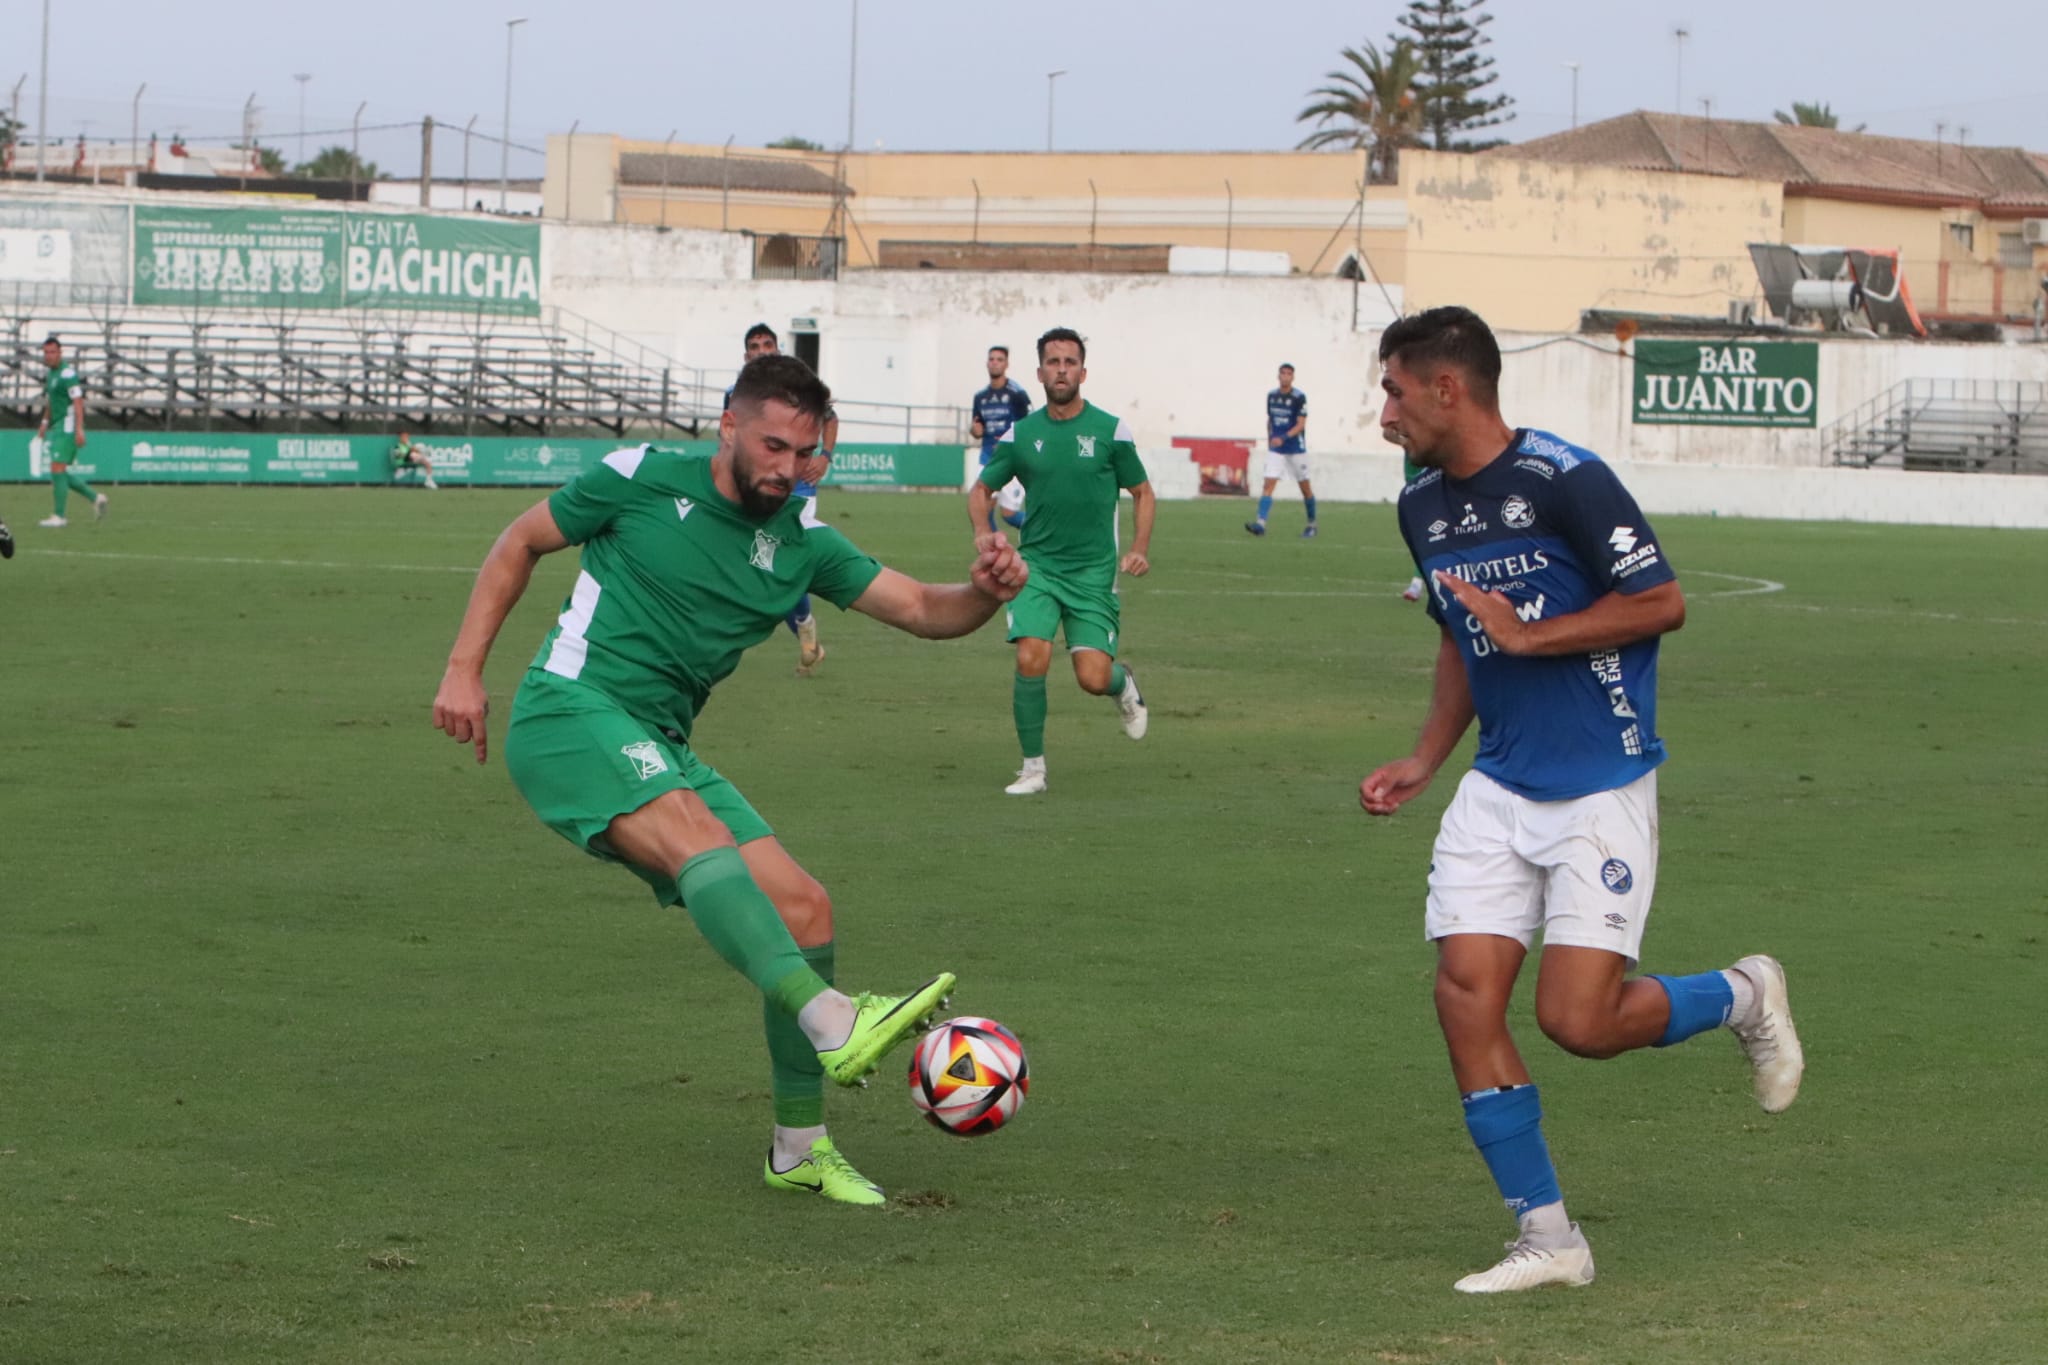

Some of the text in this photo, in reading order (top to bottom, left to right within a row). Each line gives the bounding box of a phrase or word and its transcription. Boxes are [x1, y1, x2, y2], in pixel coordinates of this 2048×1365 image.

[347, 220, 420, 246] VENTA
[153, 247, 325, 293] INFANTE
[348, 245, 538, 300] BACHICHA
[1698, 346, 1757, 374] BAR
[1639, 374, 1813, 414] JUANITO
[832, 453, 895, 470] CLIDENSA
[1611, 544, 1656, 575] SUZUKI
